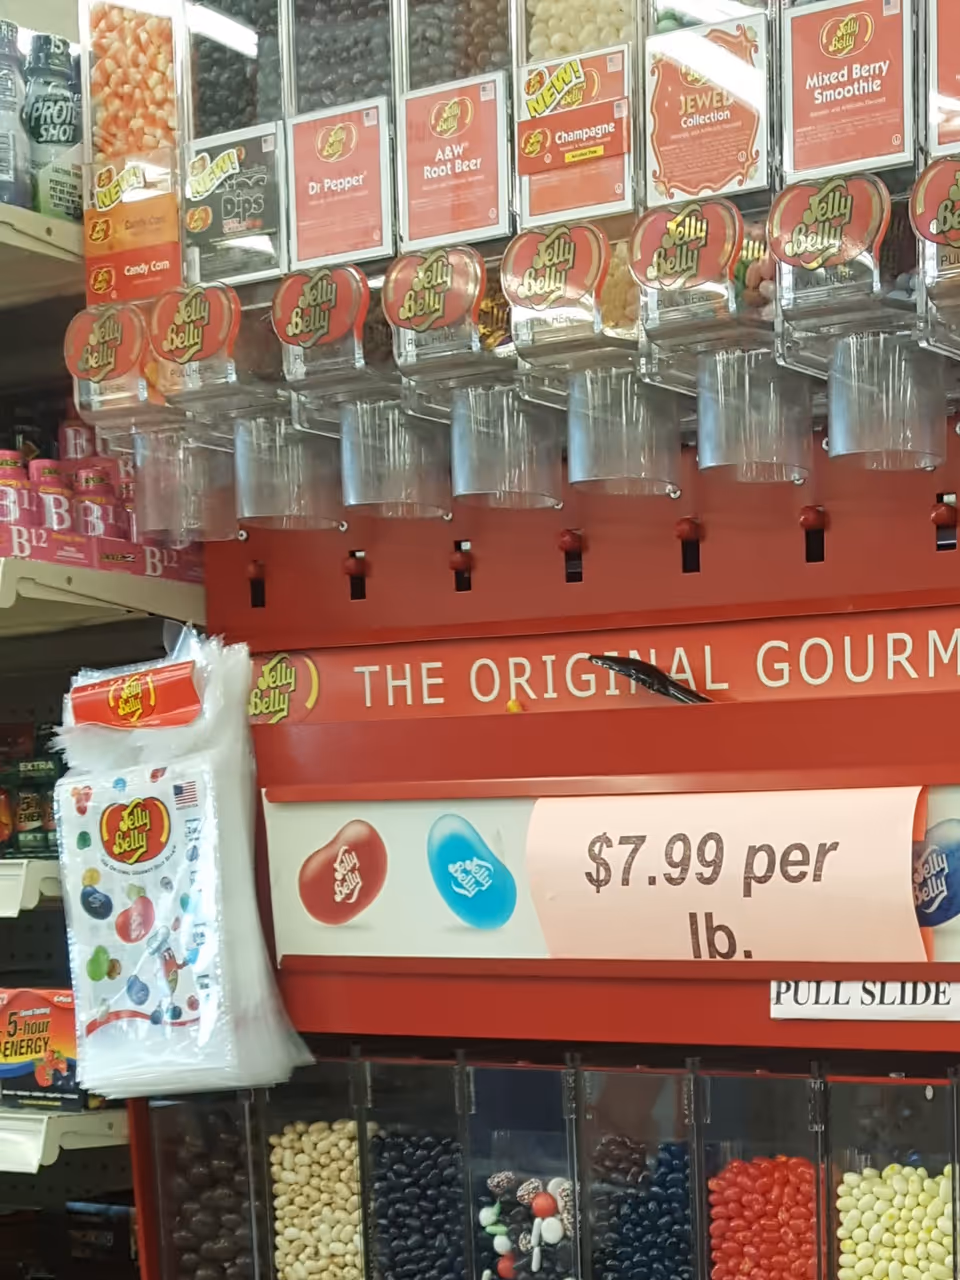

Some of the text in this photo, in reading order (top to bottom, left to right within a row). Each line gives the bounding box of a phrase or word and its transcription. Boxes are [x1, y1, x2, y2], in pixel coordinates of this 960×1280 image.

[527, 61, 584, 117] NEW!
[805, 60, 890, 90] Mixed Berry
[814, 77, 882, 105] Smoothie
[681, 109, 731, 128] Collection
[555, 122, 616, 144] Champagne
[424, 157, 482, 179] Root Beer
[308, 174, 365, 195] Dr Pepper
[803, 180, 853, 226] Jelly
[785, 222, 843, 270] Belly
[125, 259, 170, 276] Candy Corn
[353, 662, 446, 707] THE
[585, 831, 839, 899] $7.99 per
[688, 911, 753, 960] lb.
[773, 981, 851, 1006] PULL
[860, 981, 951, 1006] SLIDE
[3, 1036, 51, 1058] ENERGY
